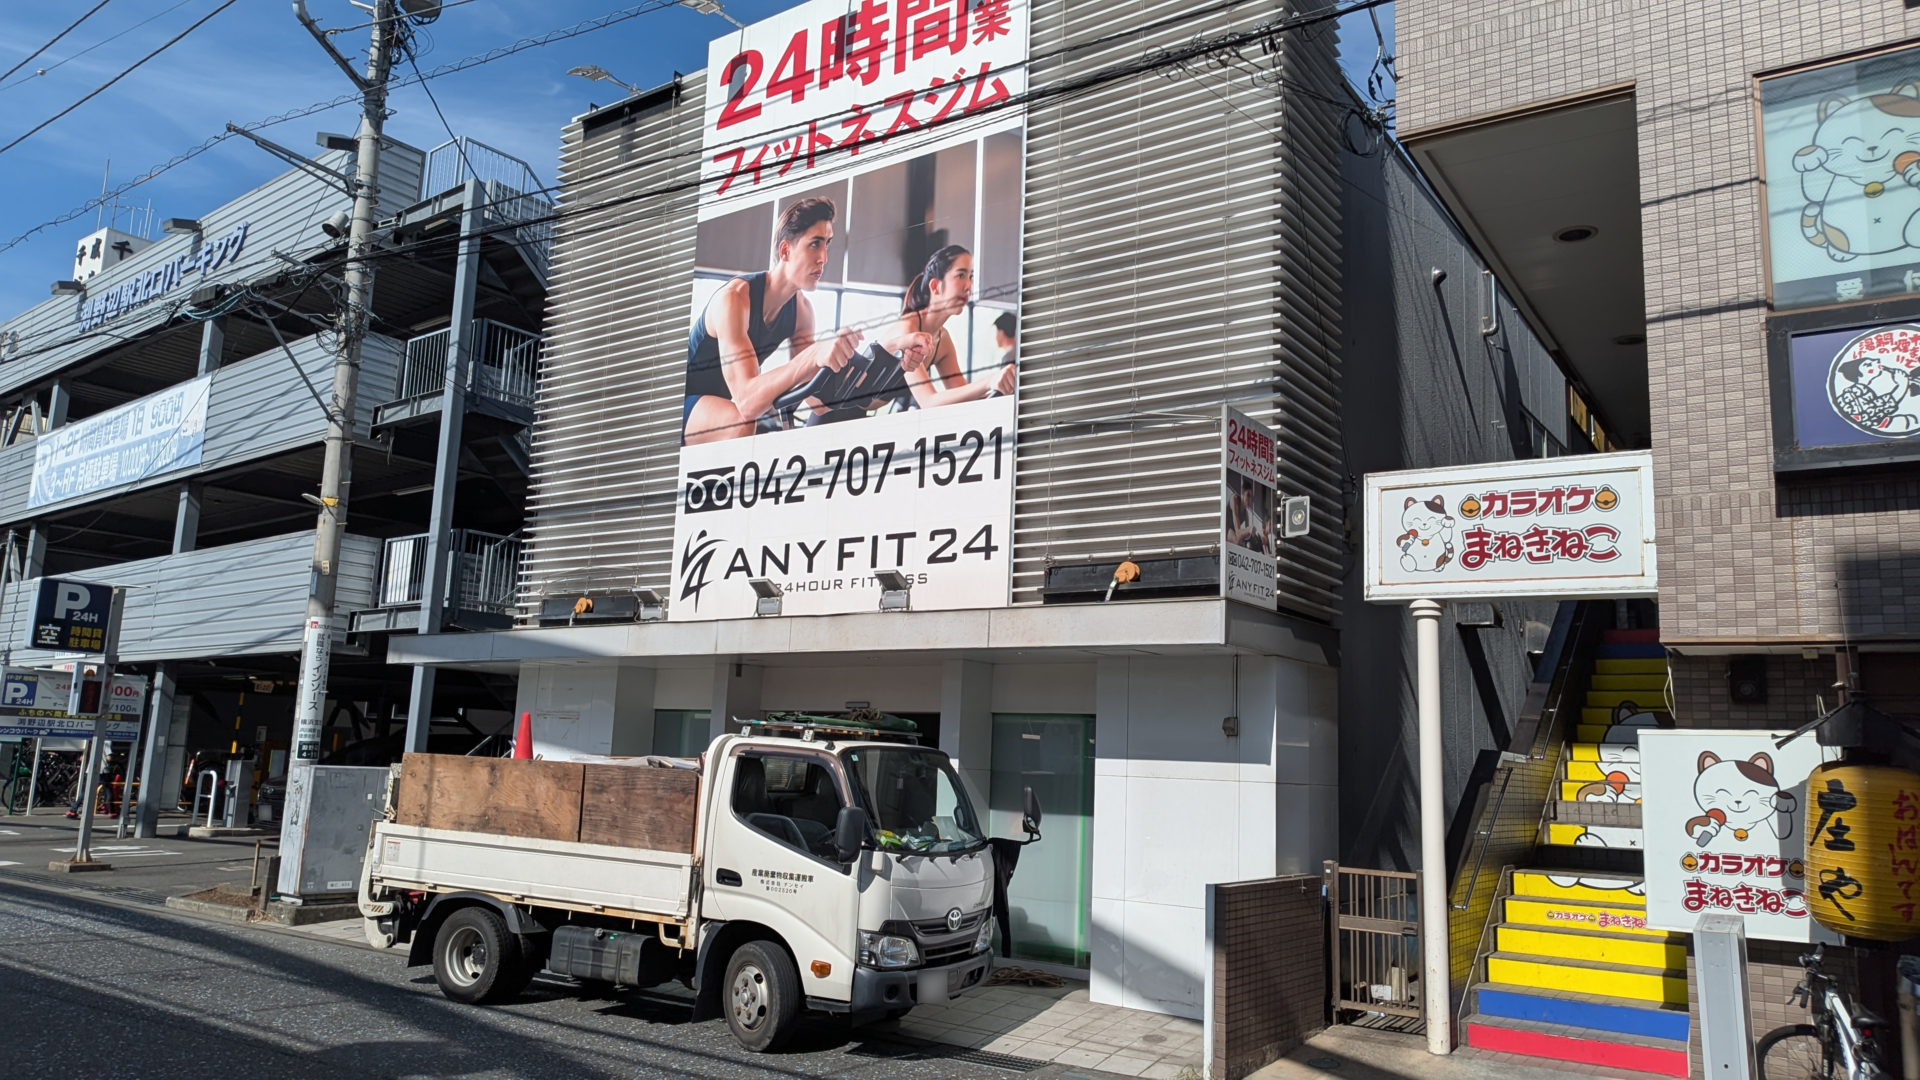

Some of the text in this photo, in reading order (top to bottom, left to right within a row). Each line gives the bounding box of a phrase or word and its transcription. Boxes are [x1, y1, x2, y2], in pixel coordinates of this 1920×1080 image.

[713, 62, 1012, 195] フィットネスジム
[739, 426, 1004, 509] 042-707-1521
[1229, 448, 1275, 483] フィットネスジム
[1480, 486, 1596, 518] カラオケ
[1462, 526, 1619, 570] まねきねこ
[851, 573, 928, 588] FITSS
[1238, 554, 1275, 580] 042-707-1521
[54, 582, 91, 619] P
[70, 625, 103, 638] 時間貸
[72, 611, 99, 623] 24H
[37, 623, 62, 645] 空
[68, 637, 102, 650] 駐車場
[4, 682, 28, 704] P
[308, 664, 322, 711] インソース
[1698, 853, 1788, 876] カラオケ
[1809, 778, 1863, 922] 庄や
[1683, 878, 1808, 917] まねきねこ
[1554, 912, 1587, 921] カラオケ
